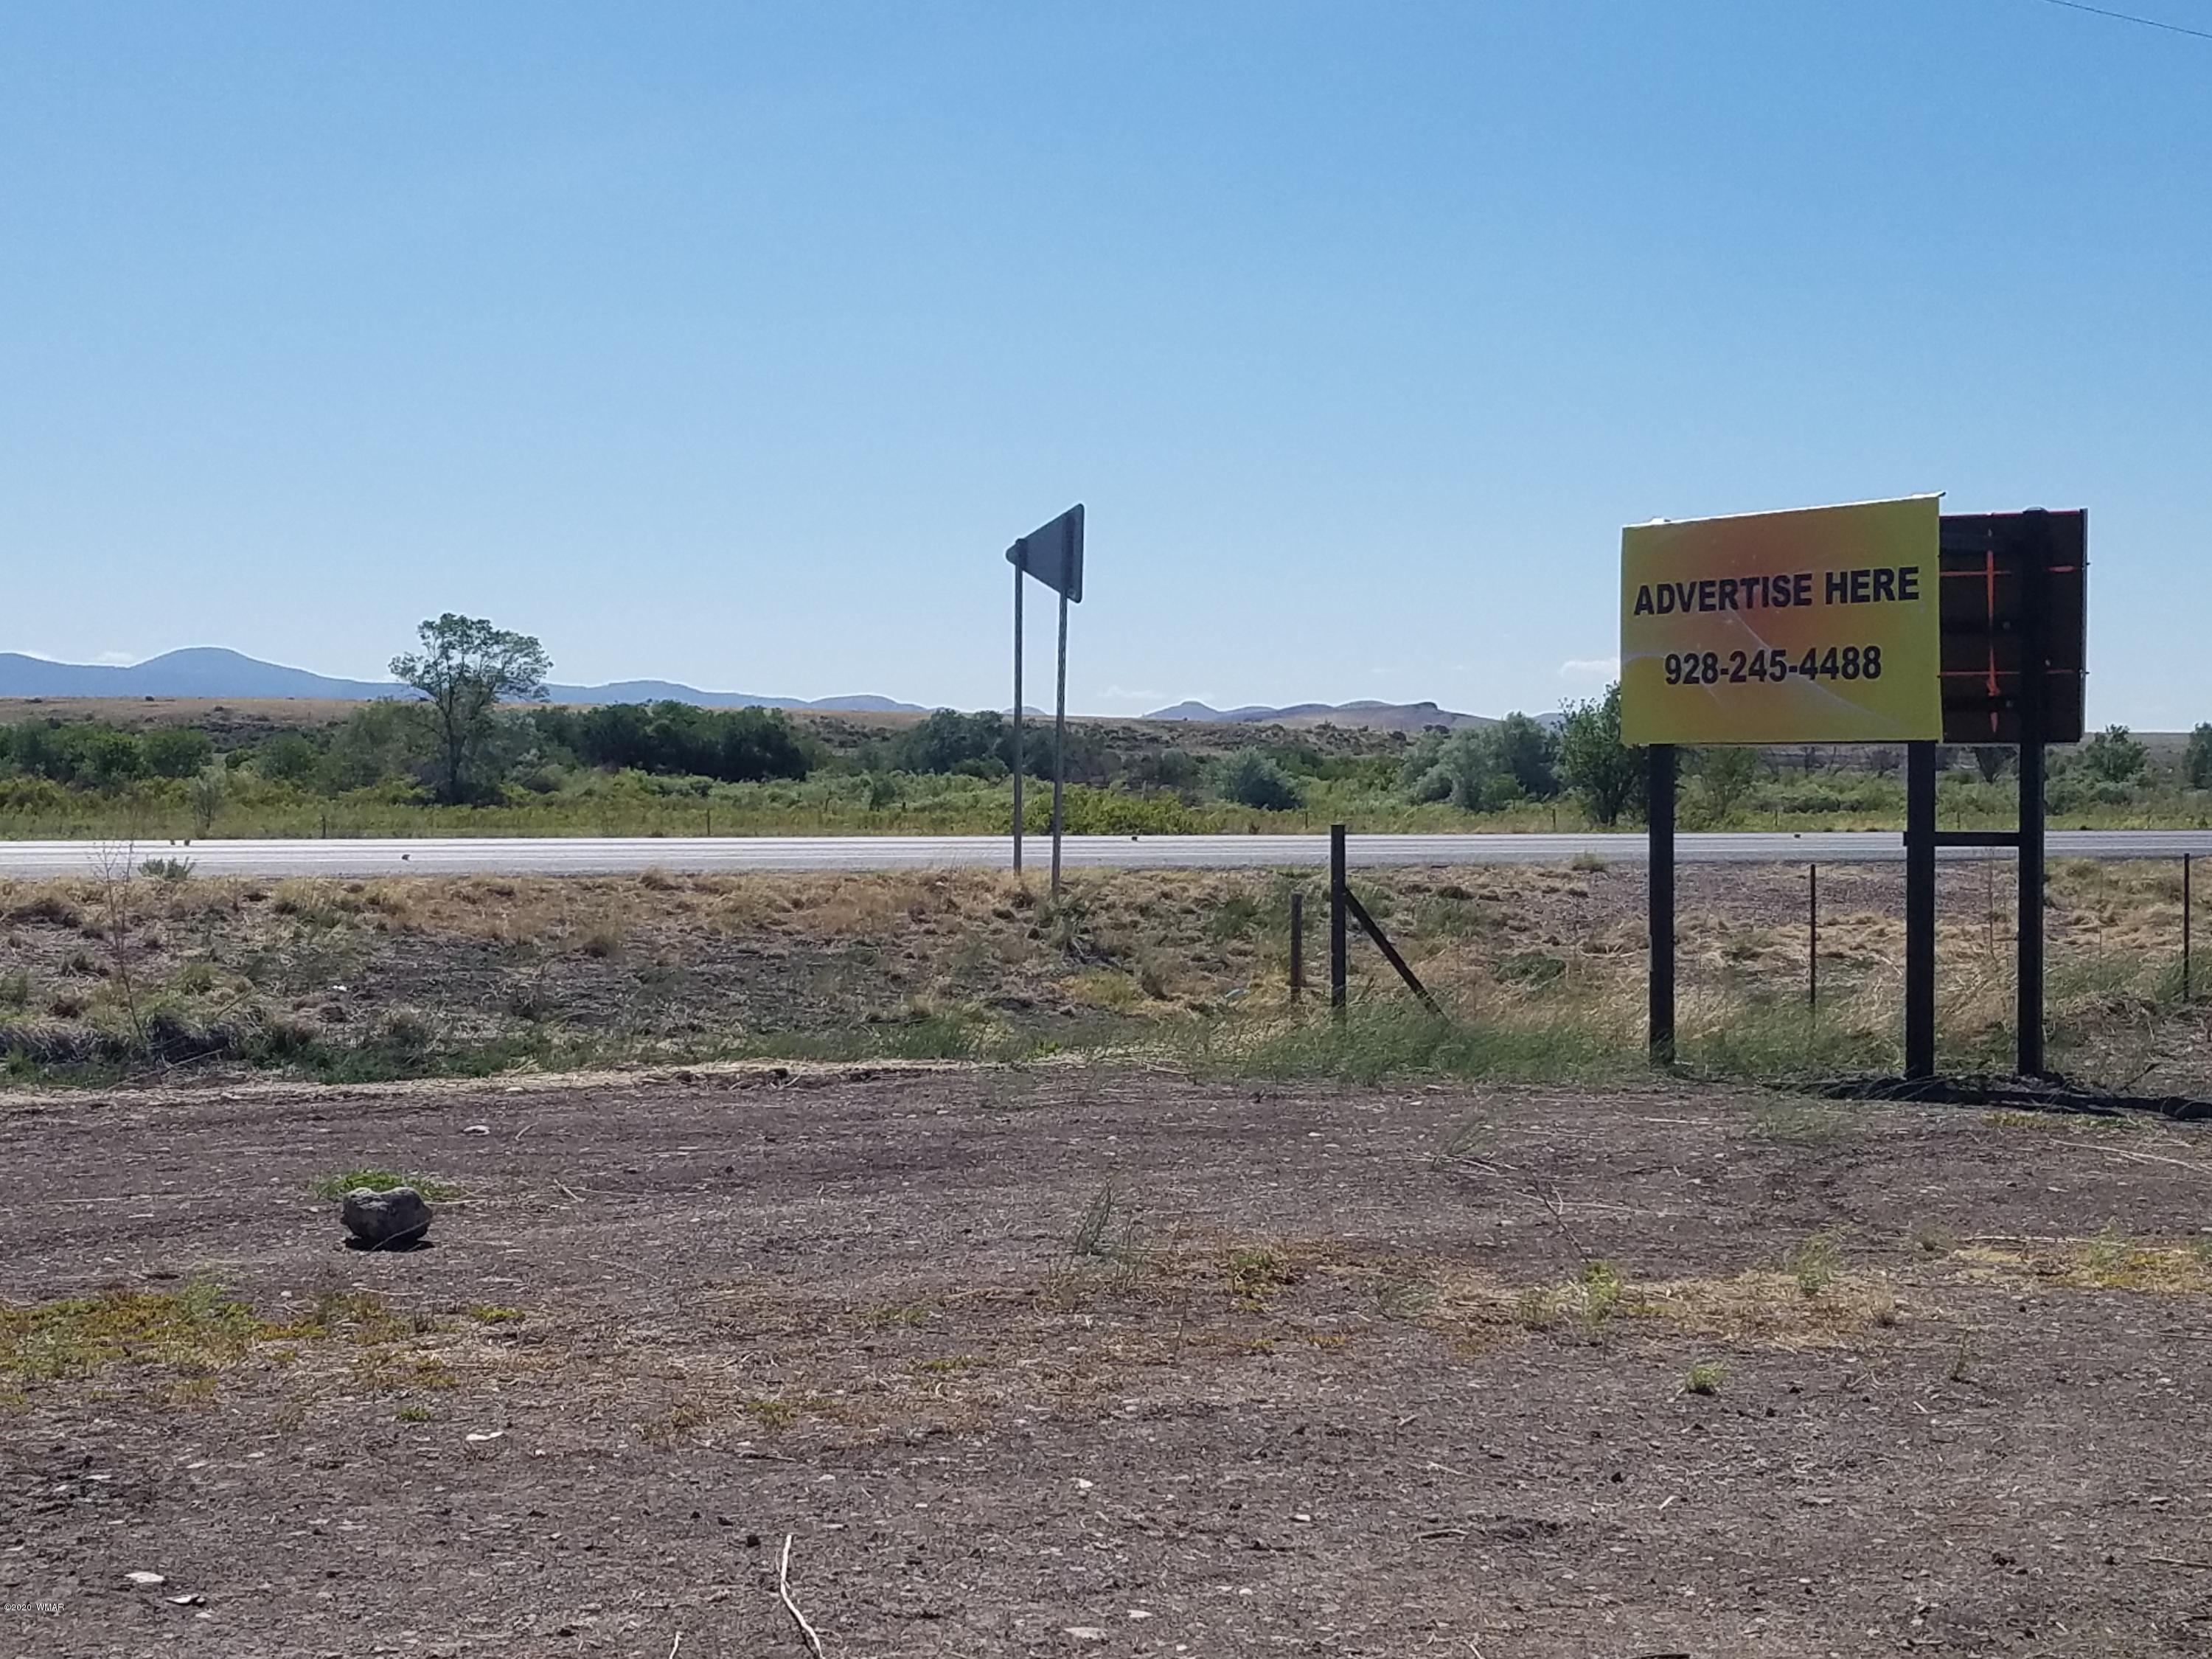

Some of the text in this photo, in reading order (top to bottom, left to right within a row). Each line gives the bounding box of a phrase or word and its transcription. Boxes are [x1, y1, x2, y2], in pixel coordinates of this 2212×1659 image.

[1633, 566, 1919, 616] ADVERTISE HERE
[1664, 644, 1882, 685] 928-245-4488
